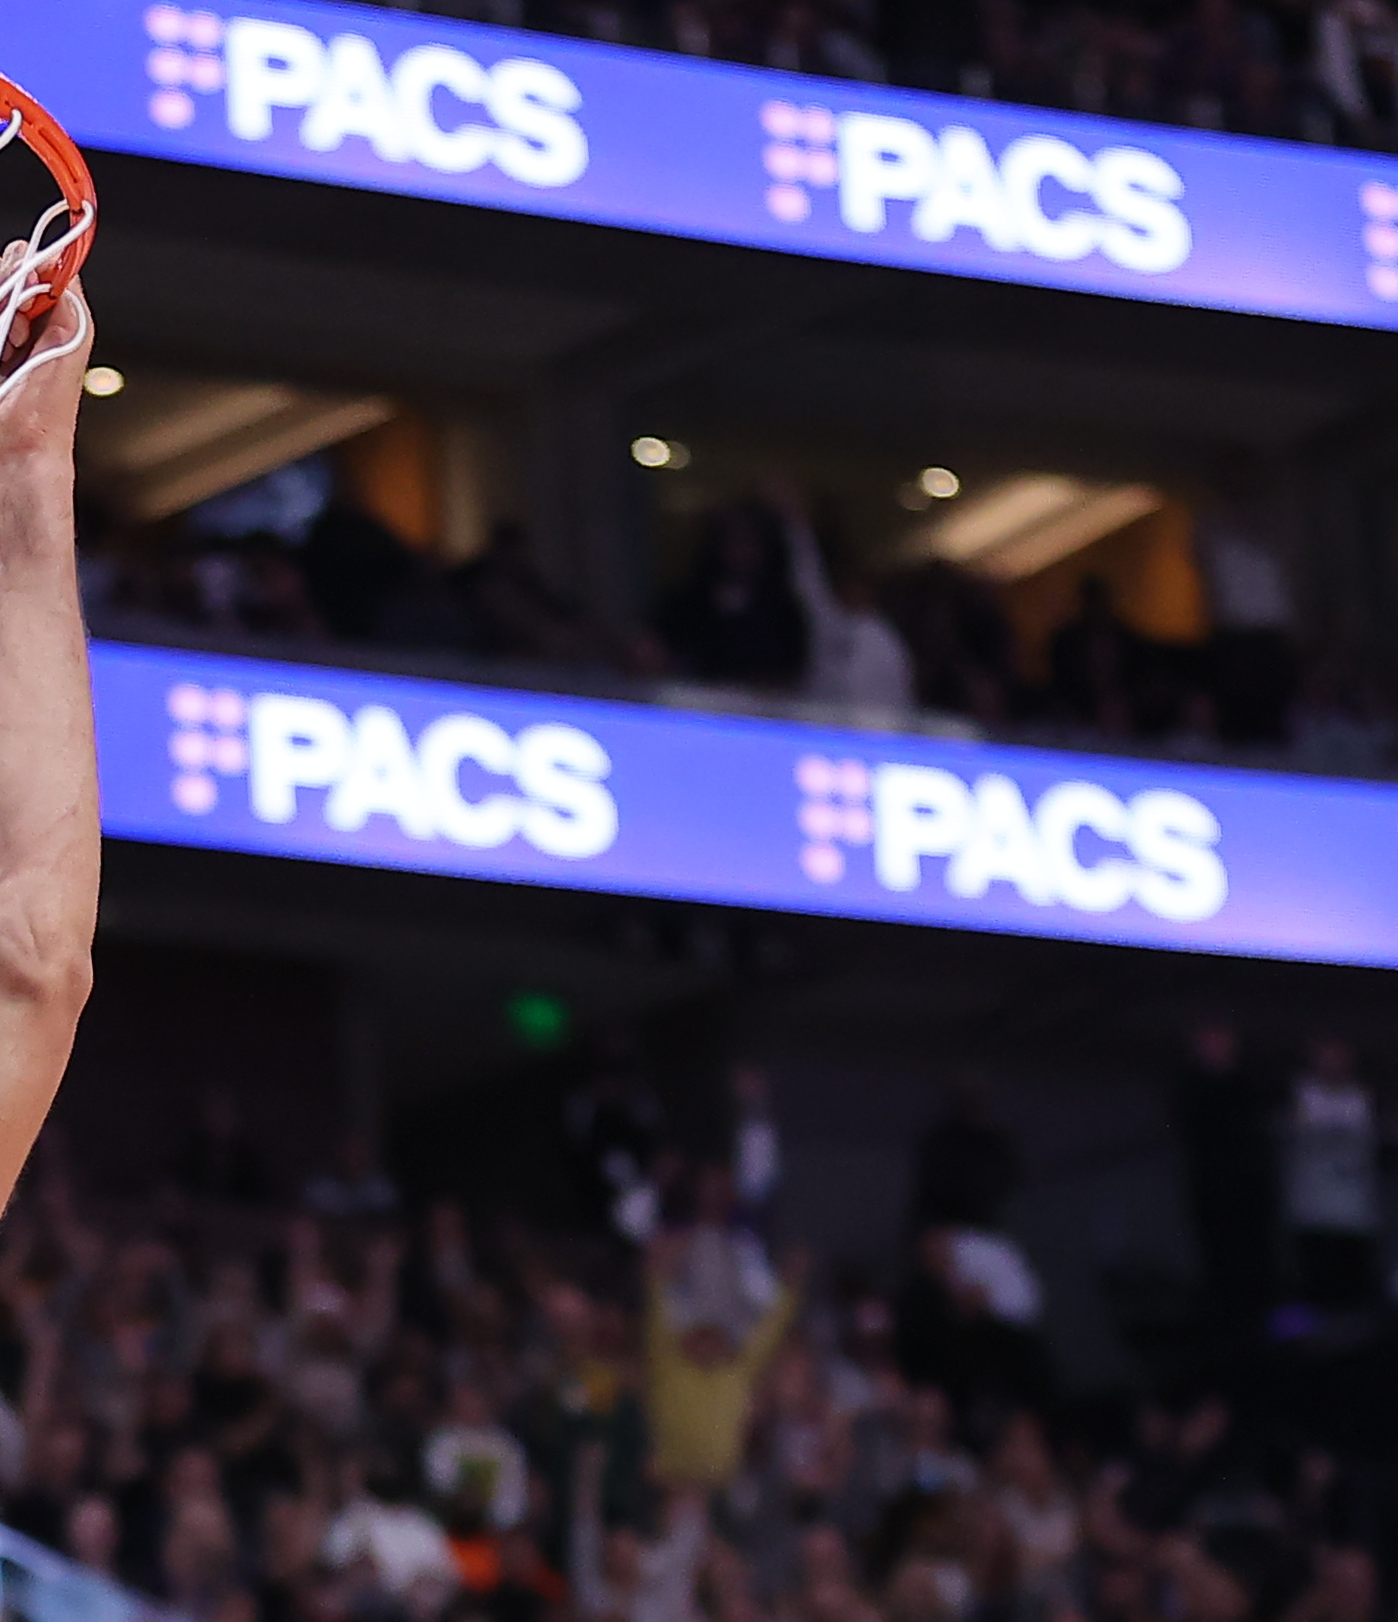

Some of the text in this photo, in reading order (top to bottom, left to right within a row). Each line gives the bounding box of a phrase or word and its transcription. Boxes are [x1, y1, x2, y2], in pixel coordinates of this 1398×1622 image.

[226, 18, 1192, 274] PACS PACS
[248, 695, 1228, 924] PACS PACS
